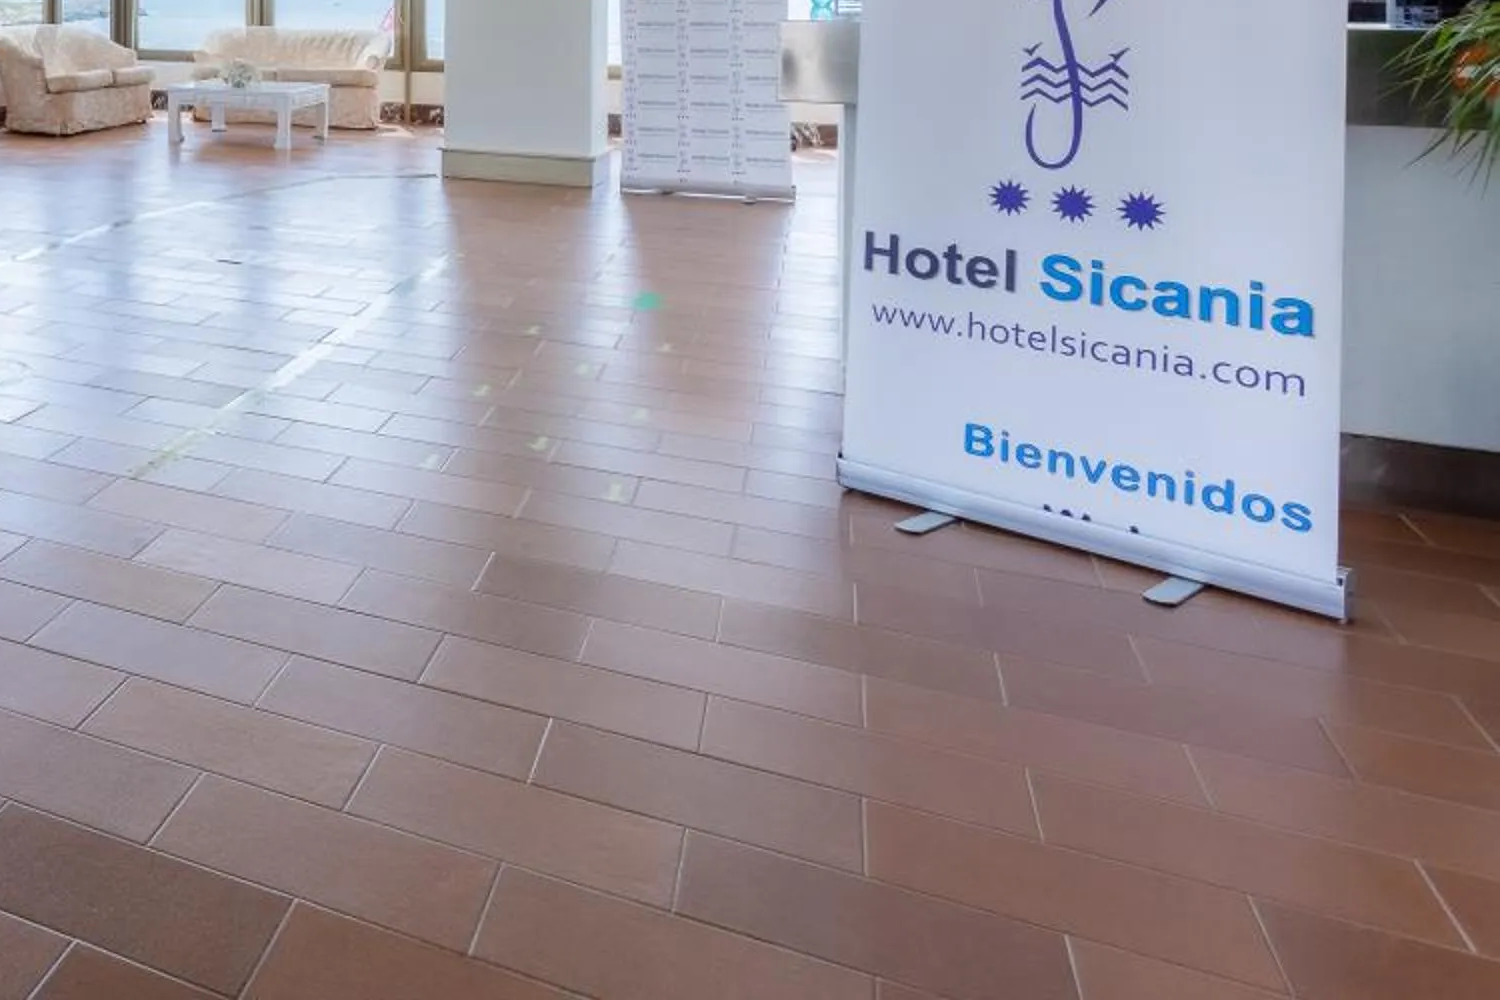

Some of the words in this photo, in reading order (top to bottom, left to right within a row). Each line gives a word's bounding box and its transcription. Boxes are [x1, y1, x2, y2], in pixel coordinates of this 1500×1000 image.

[863, 230, 1018, 293] Hotel
[1040, 253, 1315, 338] Sicania
[872, 303, 1306, 397] www.hotelsicania.com
[963, 422, 1314, 535] Bienvenidos
